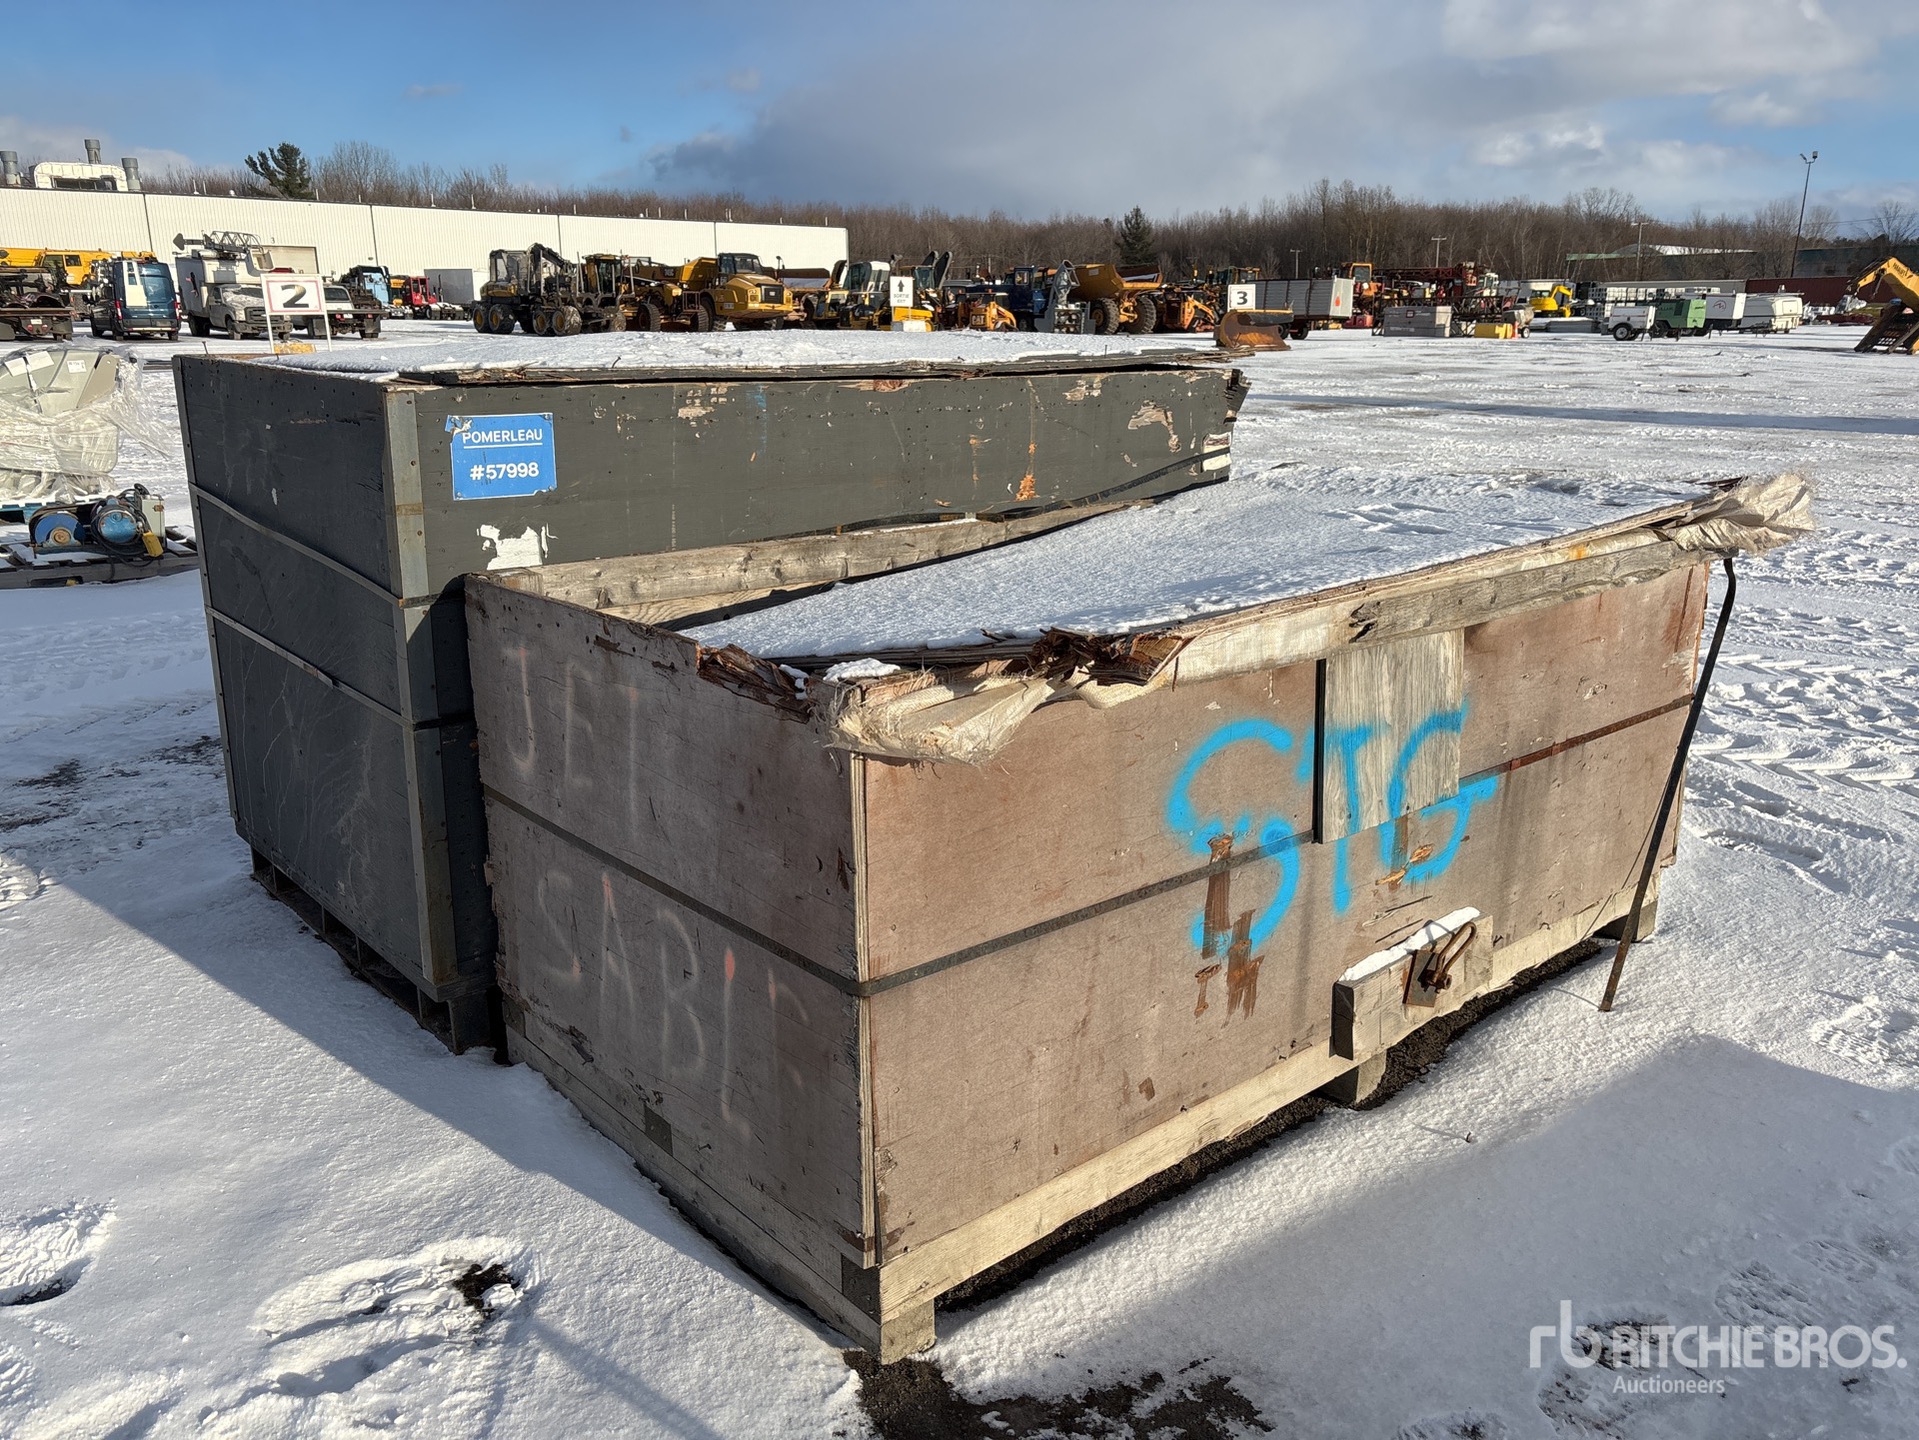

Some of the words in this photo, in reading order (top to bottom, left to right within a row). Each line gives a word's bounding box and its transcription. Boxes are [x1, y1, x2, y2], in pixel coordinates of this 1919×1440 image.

[280, 284, 310, 309] 2
[1236, 290, 1248, 306] 3
[971, 314, 985, 326] CAT
[462, 428, 543, 444] POMERLEAU
[469, 461, 540, 481] #57998
